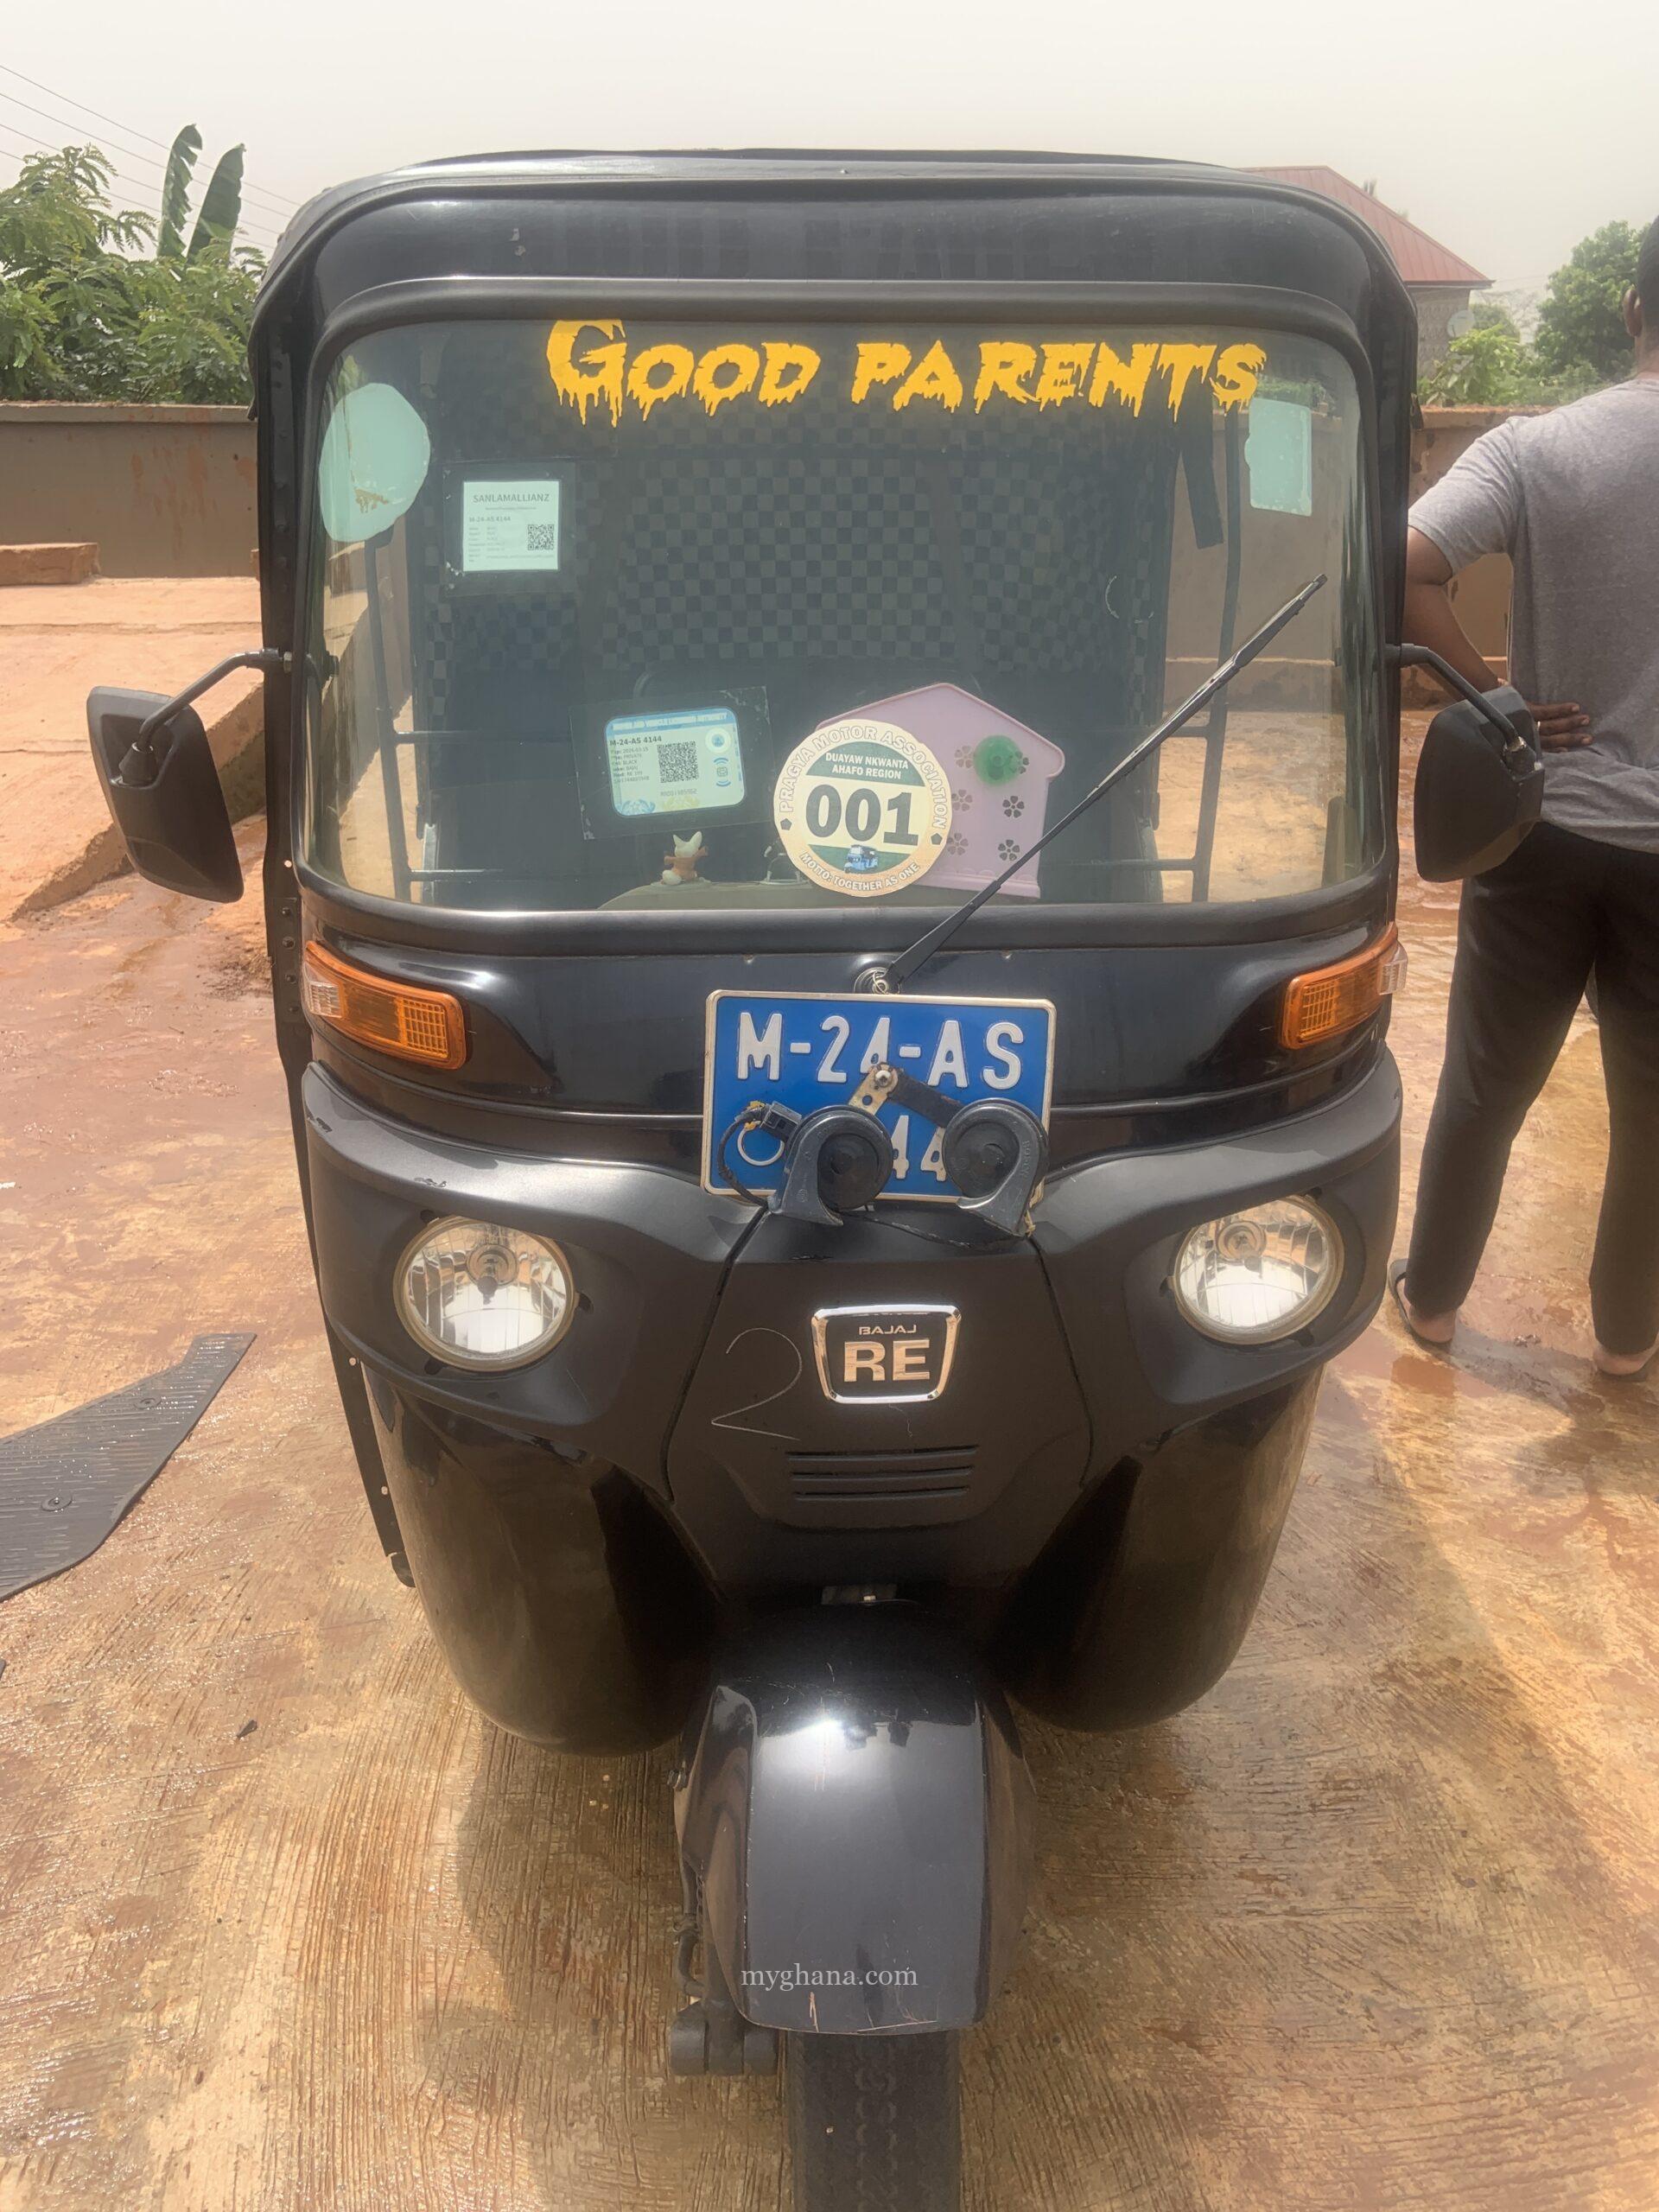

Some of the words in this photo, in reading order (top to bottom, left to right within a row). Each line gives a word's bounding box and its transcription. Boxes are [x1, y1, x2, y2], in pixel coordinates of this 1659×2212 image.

[473, 493, 550, 503] SANLAMALLIANZ
[825, 752, 865, 765] DUAYAW
[865, 753, 909, 769] NKWANTA
[831, 764, 864, 776] AHAFO
[866, 766, 902, 779] REGION
[779, 747, 815, 813] PRAGYA
[812, 725, 878, 751] MOTOR
[880, 730, 949, 830] ASSOCIATION
[805, 784, 918, 846] 001
[799, 851, 833, 881] MOTTO:
[834, 875, 883, 891] TOGETHER
[884, 876, 899, 888] AS
[899, 862, 921, 881] ONE
[858, 1325, 918, 1336] BAJAJ
[843, 1338, 931, 1382] RE
